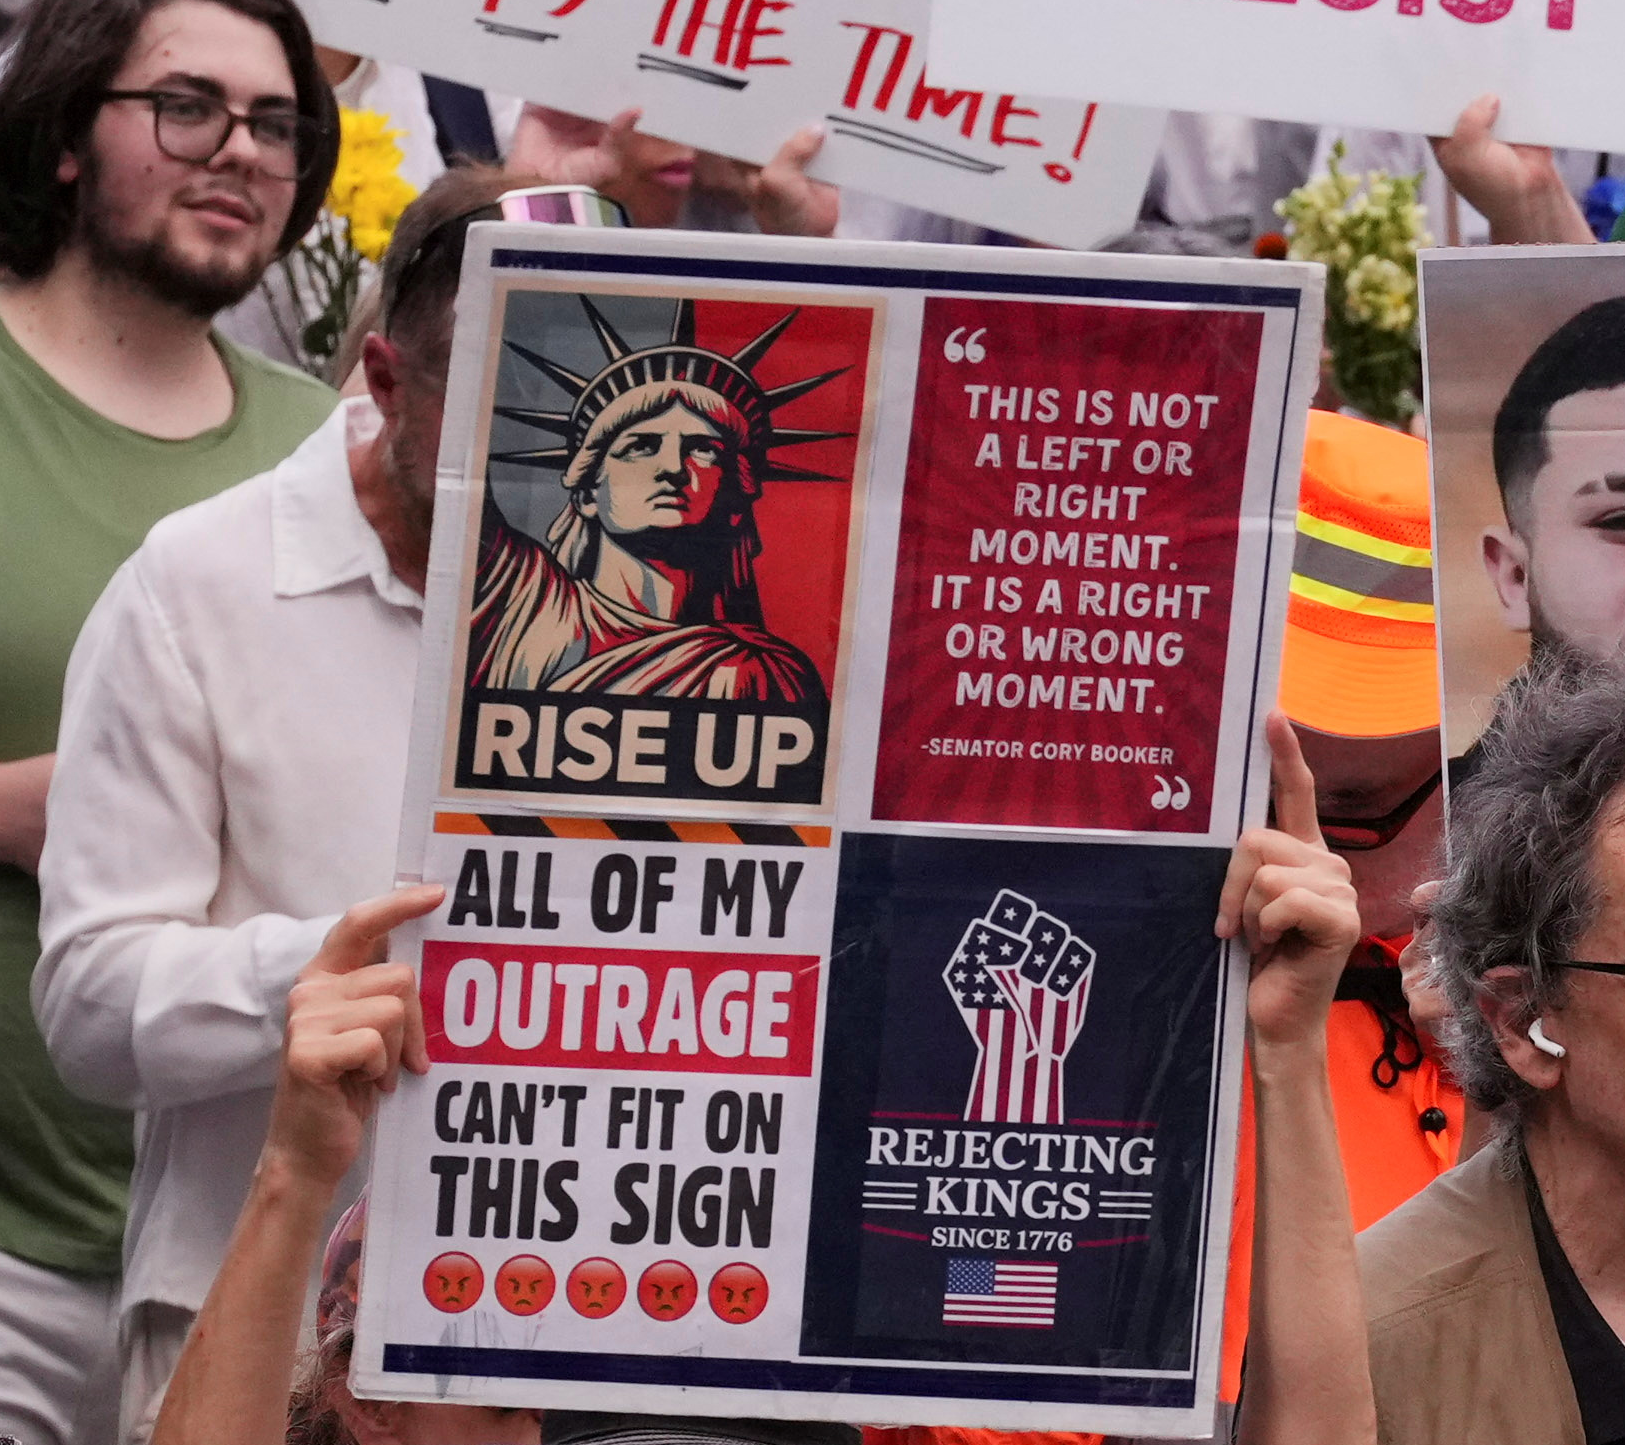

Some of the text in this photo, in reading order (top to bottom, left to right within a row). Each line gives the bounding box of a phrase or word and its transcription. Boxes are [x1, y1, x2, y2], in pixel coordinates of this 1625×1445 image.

[837, 18, 1099, 186] TIME!
[963, 384, 1220, 430] THIS IS NOT
[974, 433, 1195, 478] A LEFT OR
[1012, 482, 1148, 522] RIGHT
[969, 528, 1179, 572] MOMENT.
[929, 573, 1212, 621] IT IS A RIGHT
[944, 622, 1187, 668] OR WRONG
[953, 670, 1165, 716] MOMENT.
[470, 702, 816, 793] RISE UP
[1028, 740, 1086, 762] CORY
[1089, 742, 1175, 766] BOOKER
[446, 848, 806, 941] ALL OF MY
[440, 955, 792, 1059] OUTRAGE
[433, 1078, 785, 1156] CAN'T FIT ON
[865, 1126, 1158, 1177] REJECTING
[429, 1154, 775, 1250] THIS SIGN
[922, 1175, 1092, 1221] KINGS
[930, 1226, 1075, 1254] SINCE 1776
